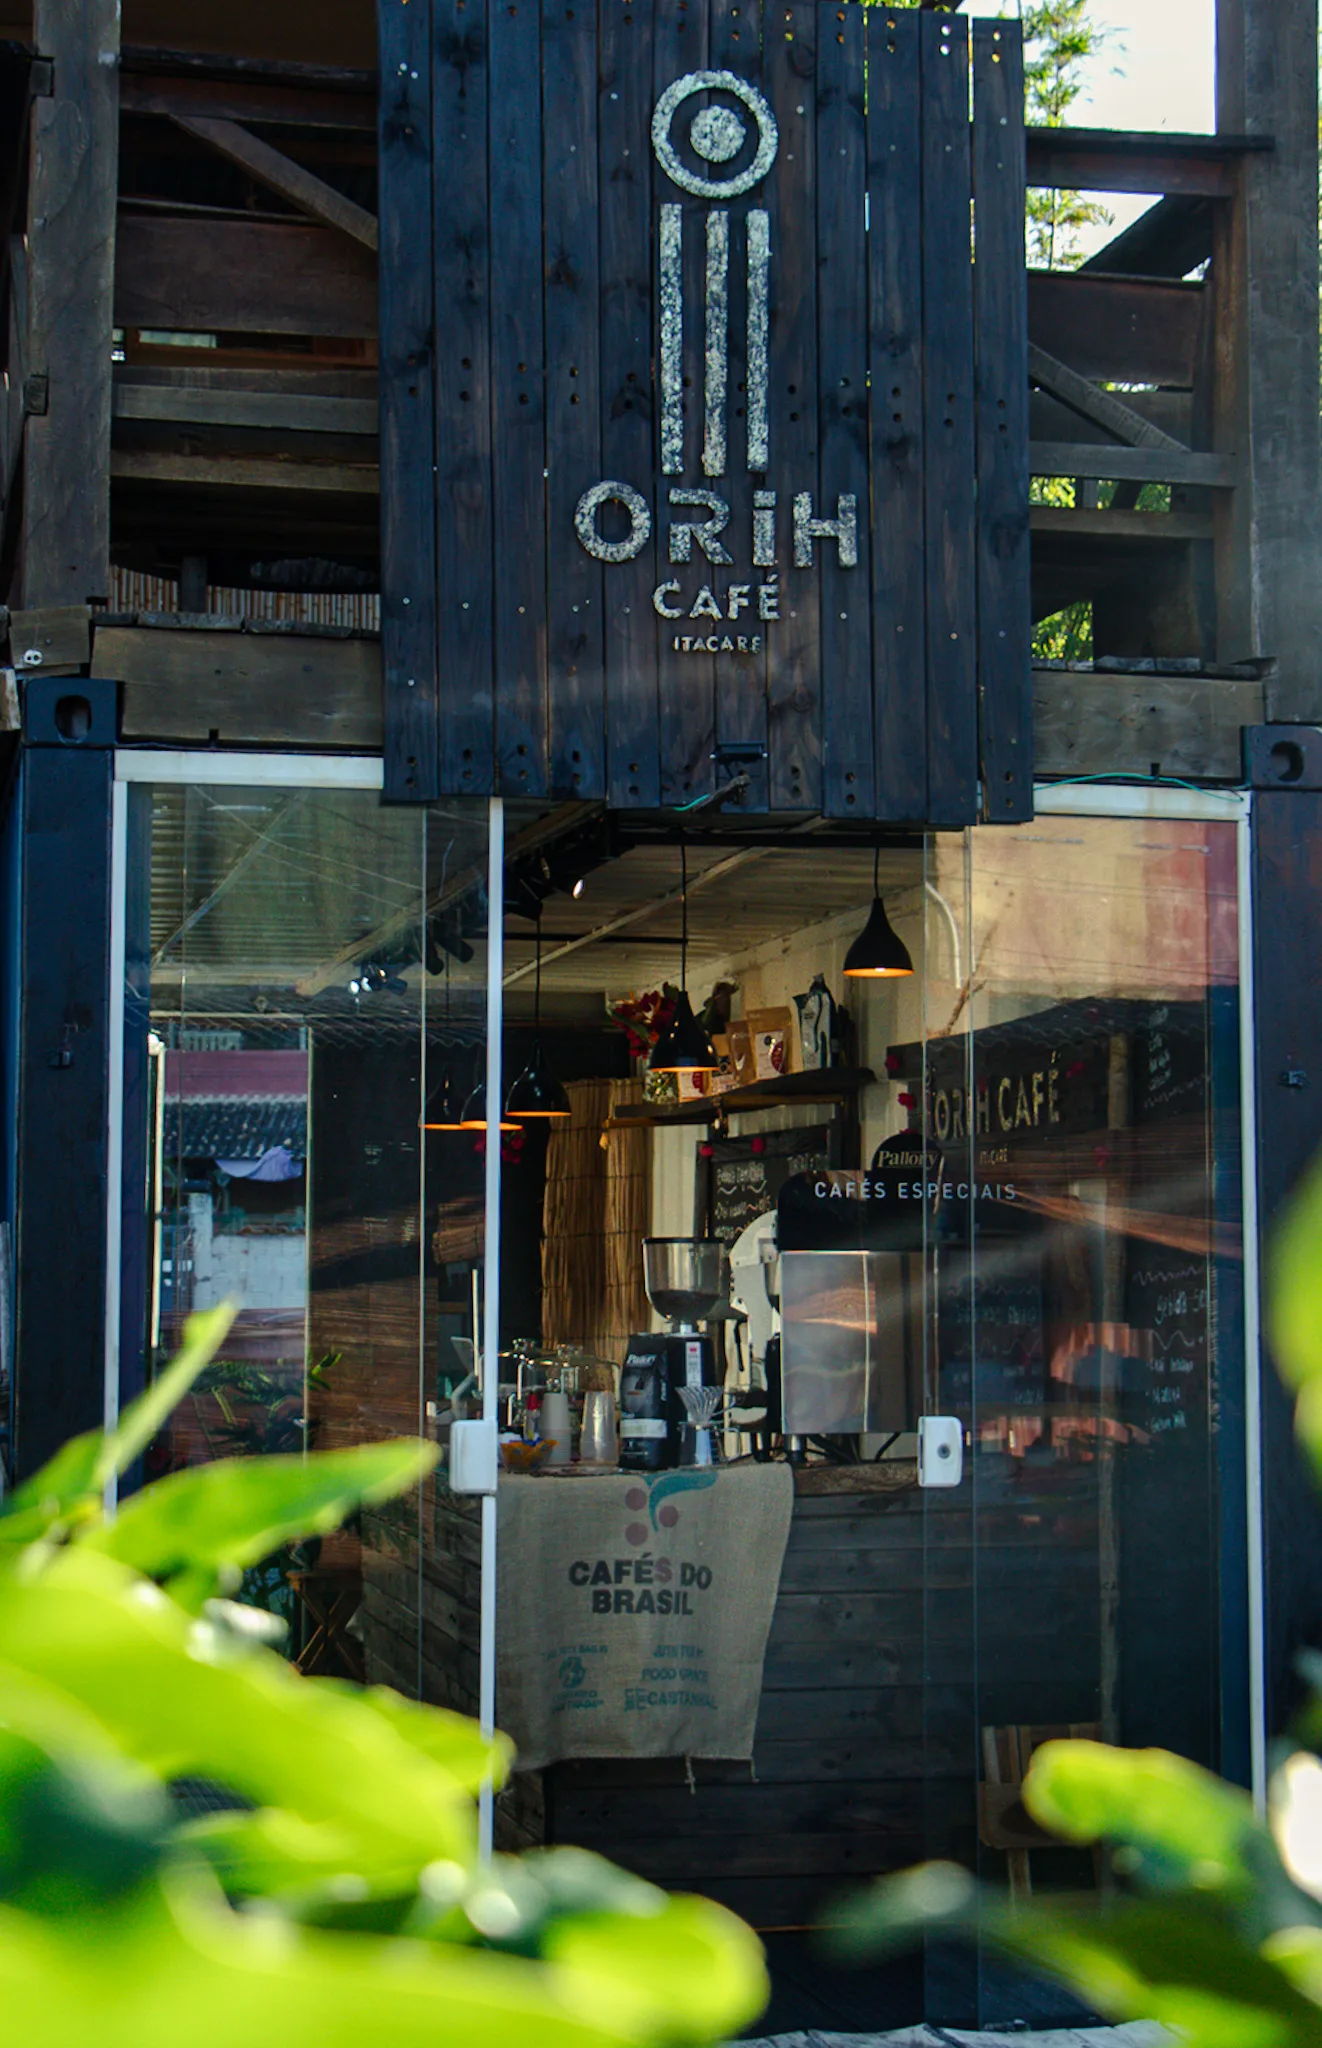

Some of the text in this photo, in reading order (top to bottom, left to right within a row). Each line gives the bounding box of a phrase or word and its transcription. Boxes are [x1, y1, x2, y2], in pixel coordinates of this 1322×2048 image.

[653, 573, 780, 621] CAFÉ
[997, 1050, 1061, 1133] CAFÉ
[877, 1150, 941, 1171] Pallory
[814, 1178, 1016, 1200] CAFÉS ESPECIAIS
[568, 1552, 713, 1590] CAFÉS DO
[592, 1589, 694, 1616] BRASIL
